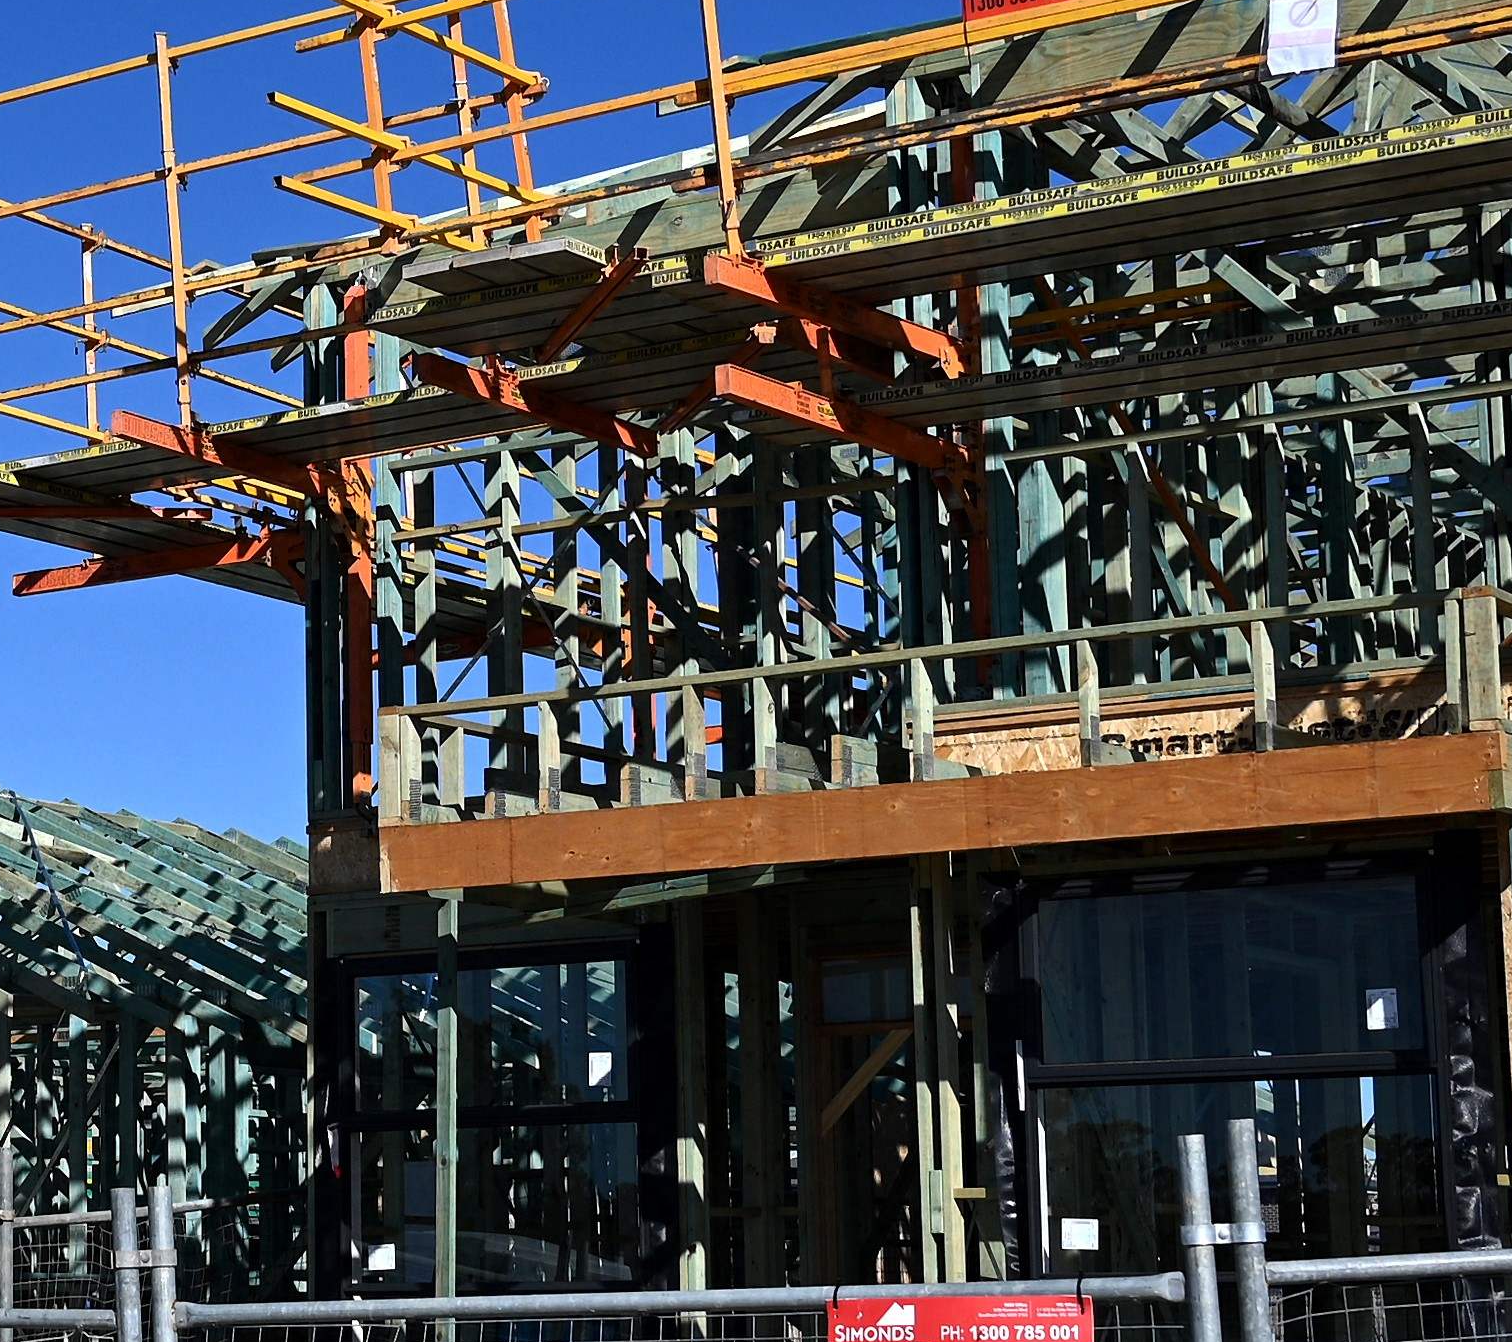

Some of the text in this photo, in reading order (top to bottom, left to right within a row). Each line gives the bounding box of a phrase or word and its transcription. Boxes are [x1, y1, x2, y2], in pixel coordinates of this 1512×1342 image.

[867, 213, 934, 233] BUILDSAFE
[1008, 186, 1078, 207] BUILDSAFE
[1156, 159, 1231, 181] BUILDSAFE
[1311, 131, 1389, 153] BUILDSAFE
[784, 242, 851, 262] BUILDSAFE
[922, 218, 992, 238] BUILDSAFE
[1066, 192, 1139, 213] BUILDSAFE
[1218, 164, 1293, 186] BUILDSAFE
[1376, 136, 1456, 158] BUILDSAFE
[480, 283, 539, 302] BUILDSAFE
[1138, 344, 1208, 363] BUILDSAFE
[1285, 323, 1360, 344] BUILDSAFE
[515, 362, 568, 379] UILDSAFE
[994, 366, 1064, 385] BUILDSAFE
[860, 385, 925, 404] BUILDSAFE
[208, 419, 246, 433] LDSAFE
[834, 1324, 915, 1342] SIMONDS
[940, 1324, 1080, 1341] PH: 1300 785 001
